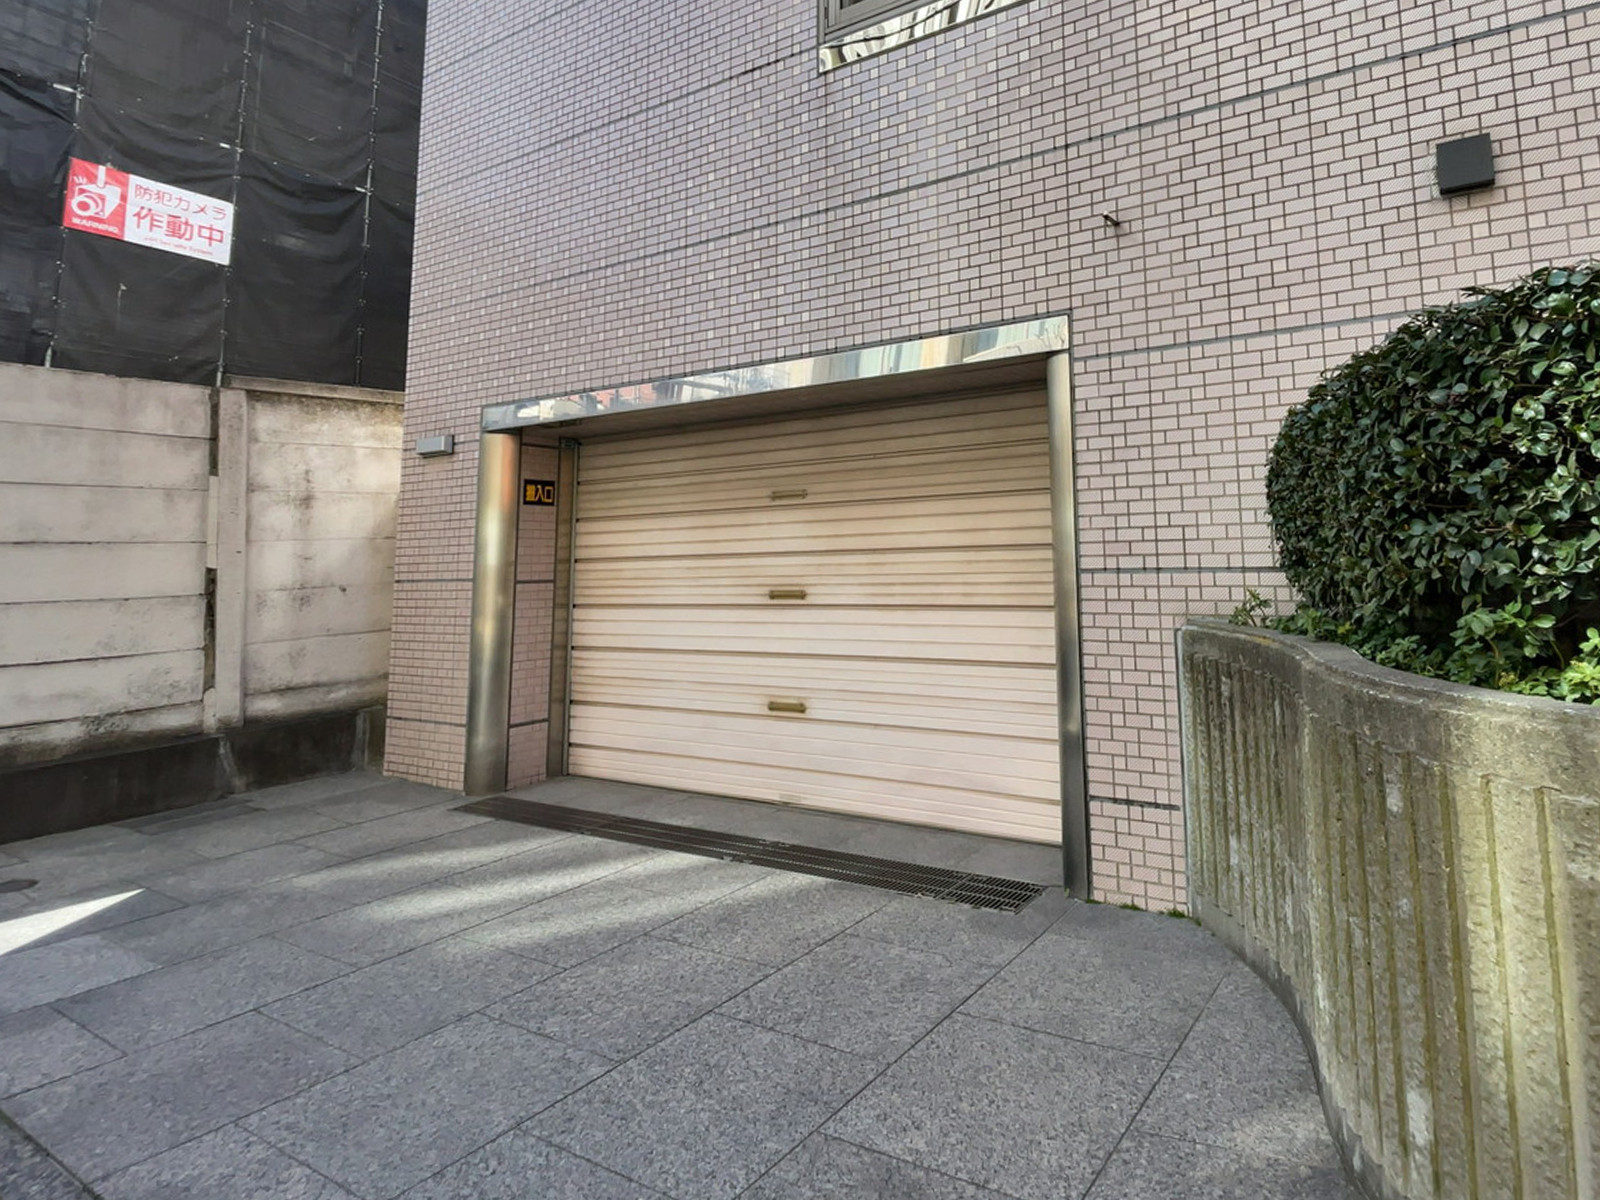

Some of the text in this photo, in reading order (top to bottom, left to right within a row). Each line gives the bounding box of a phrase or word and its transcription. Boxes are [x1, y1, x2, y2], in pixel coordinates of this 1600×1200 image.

[135, 184, 227, 220] 防犯カメラ
[132, 206, 225, 247] 作動中
